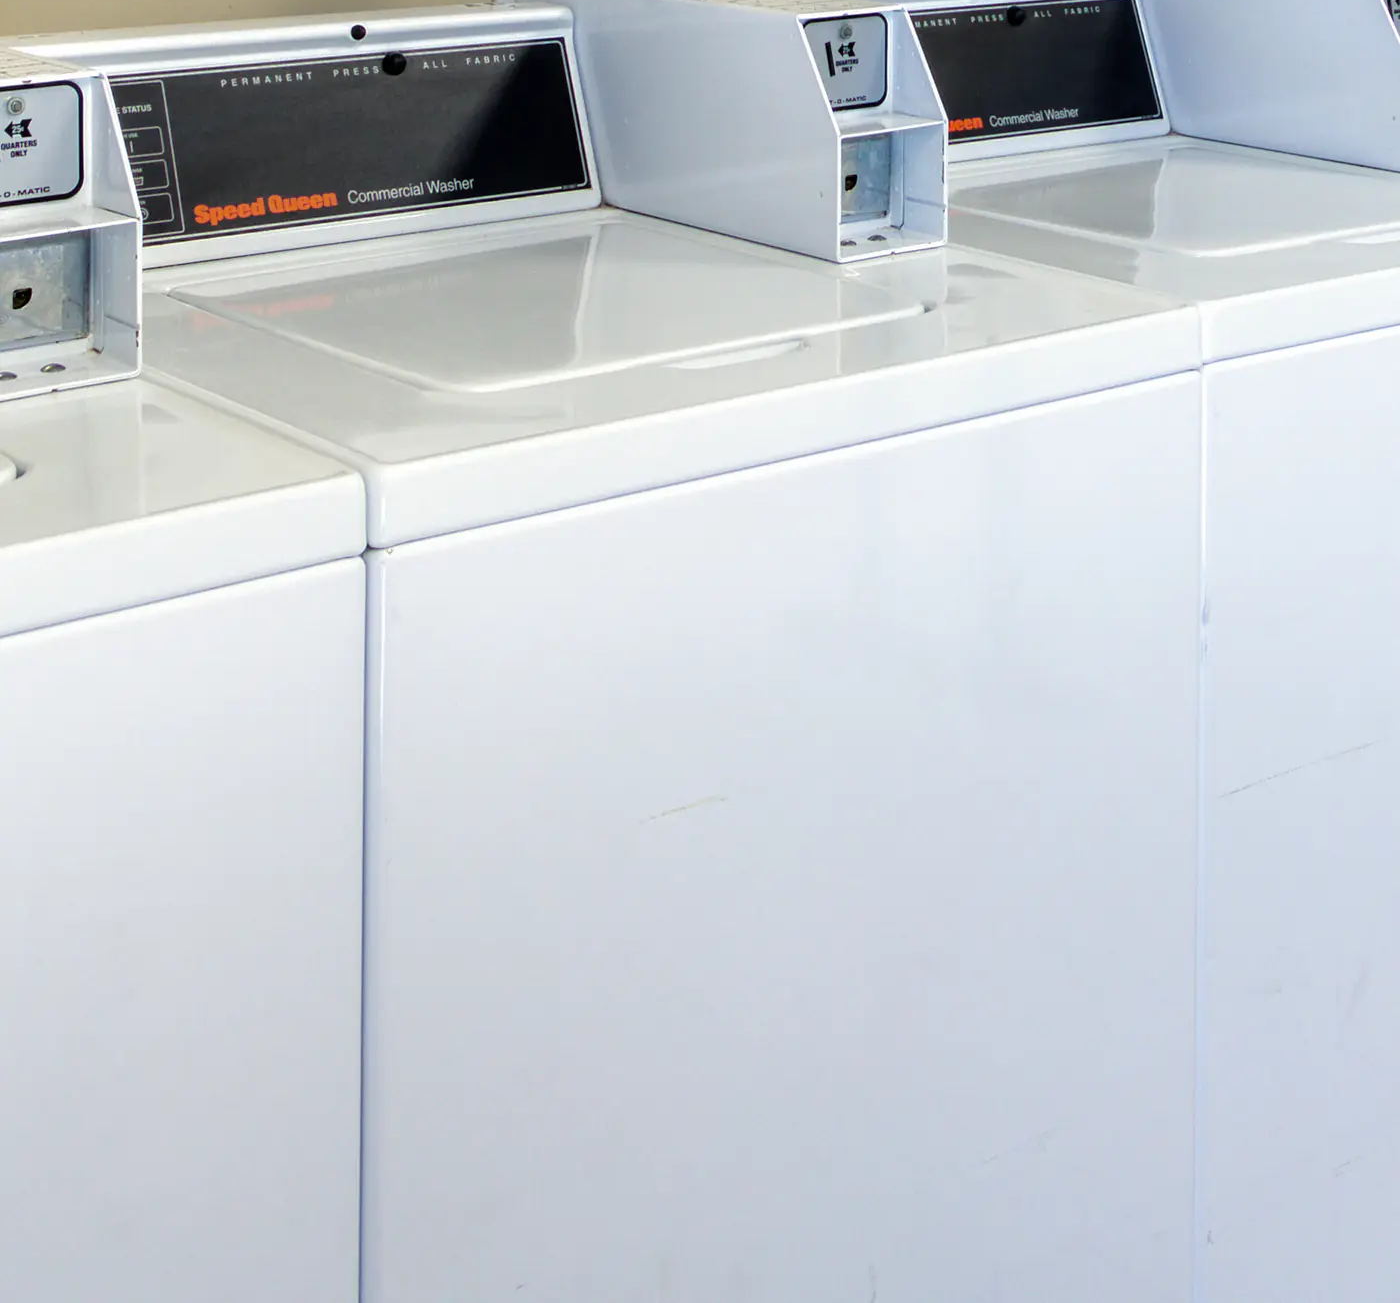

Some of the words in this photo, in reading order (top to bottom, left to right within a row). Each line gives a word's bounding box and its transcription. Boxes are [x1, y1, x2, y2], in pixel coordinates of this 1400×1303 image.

[970, 13, 1005, 23] PRESS
[1033, 9, 1053, 19] ALL
[1064, 5, 1101, 16] FABRIC
[422, 58, 449, 70] ALL
[465, 52, 517, 67] FABRIC
[219, 71, 314, 88] PERMANENT
[332, 64, 381, 78] PRESS
[121, 104, 153, 115] STATUS
[989, 109, 1044, 128] Commercial
[1044, 106, 1079, 121] Washer
[0, 139, 38, 151] QUARTERS
[10, 150, 28, 158] ONLY
[194, 197, 265, 226] Speed
[268, 190, 338, 214] Queen
[347, 183, 424, 205] Commercial
[426, 175, 475, 196] Washer
